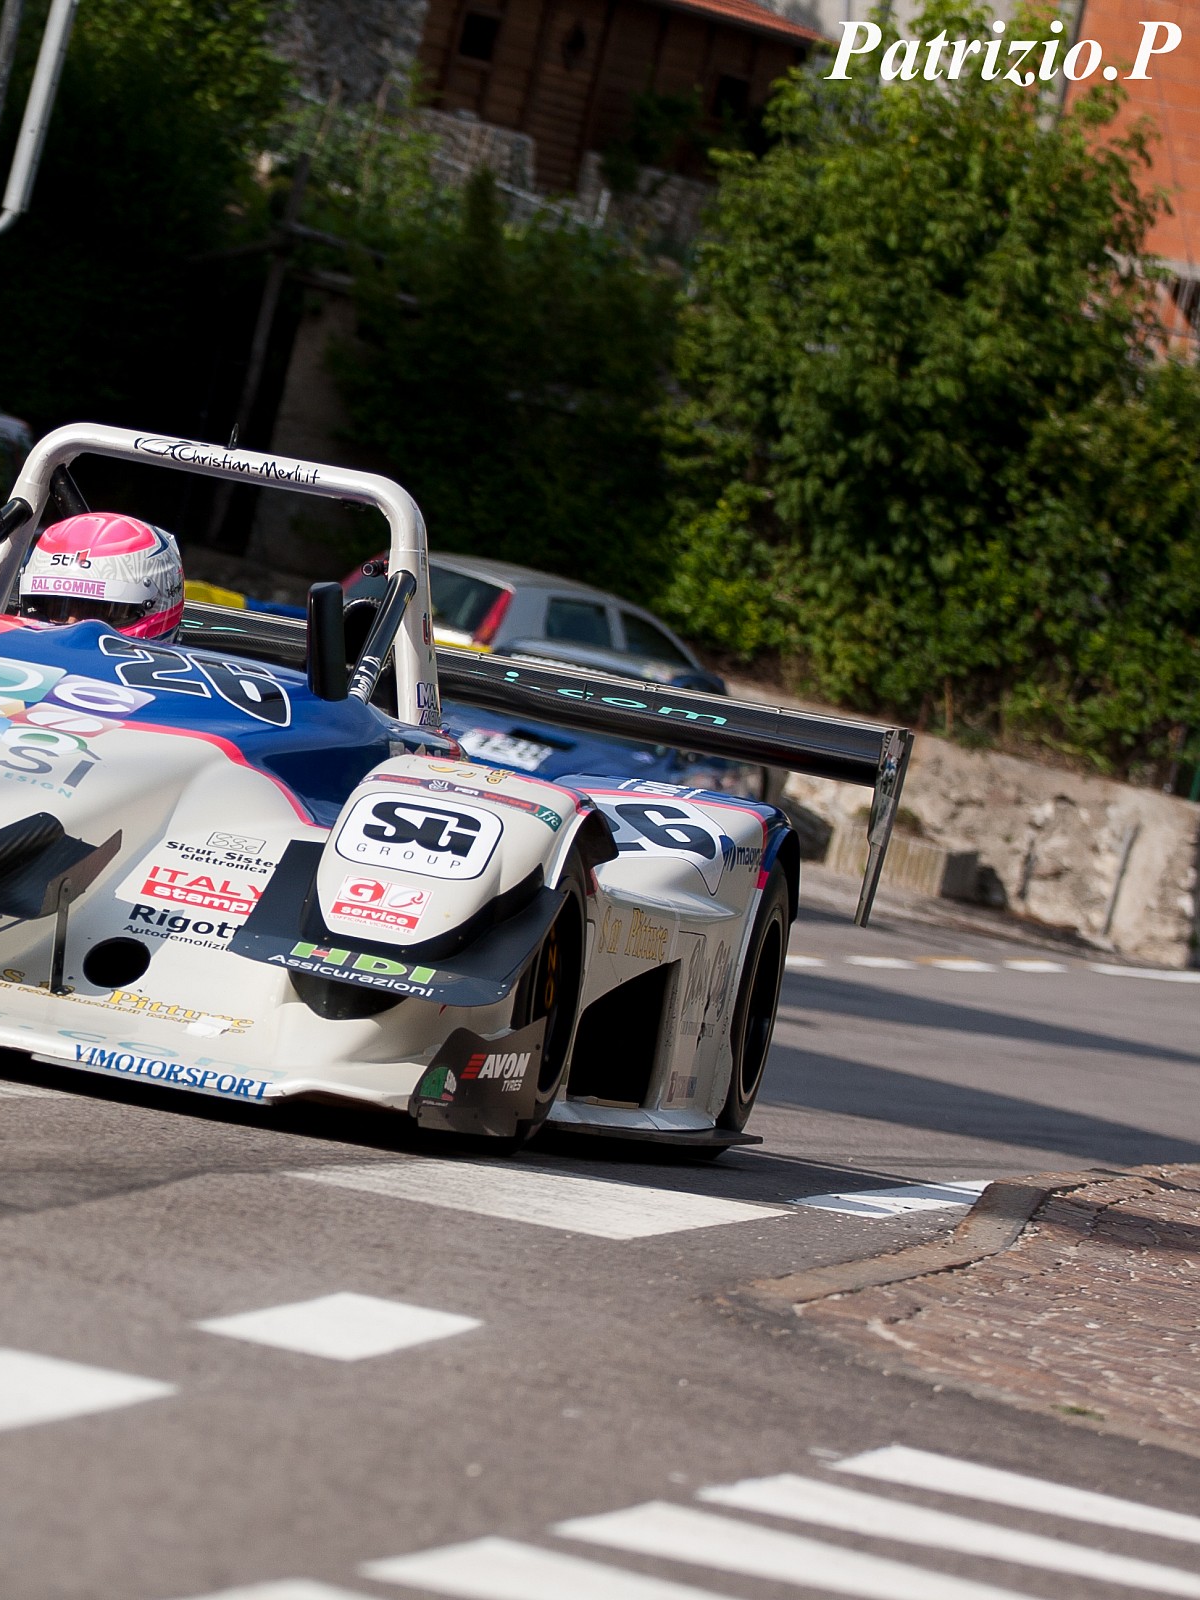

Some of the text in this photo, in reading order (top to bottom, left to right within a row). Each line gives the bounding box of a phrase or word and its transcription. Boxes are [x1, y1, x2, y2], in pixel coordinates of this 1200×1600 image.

[31, 579, 106, 597] RAL GOMME
[99, 634, 291, 728] 26
[454, 787, 479, 796] PER
[362, 801, 482, 858] SG
[166, 840, 279, 869] Sicur Siste
[180, 853, 268, 875] elettronica
[356, 842, 461, 869] GROUP
[340, 905, 409, 926] service
[267, 953, 434, 997] Assicurazioni
[289, 942, 437, 985] HDI
[75, 1043, 273, 1100] VIMOTORSPORT
[477, 1052, 532, 1079] AVON
[501, 1079, 523, 1092] TYRES
